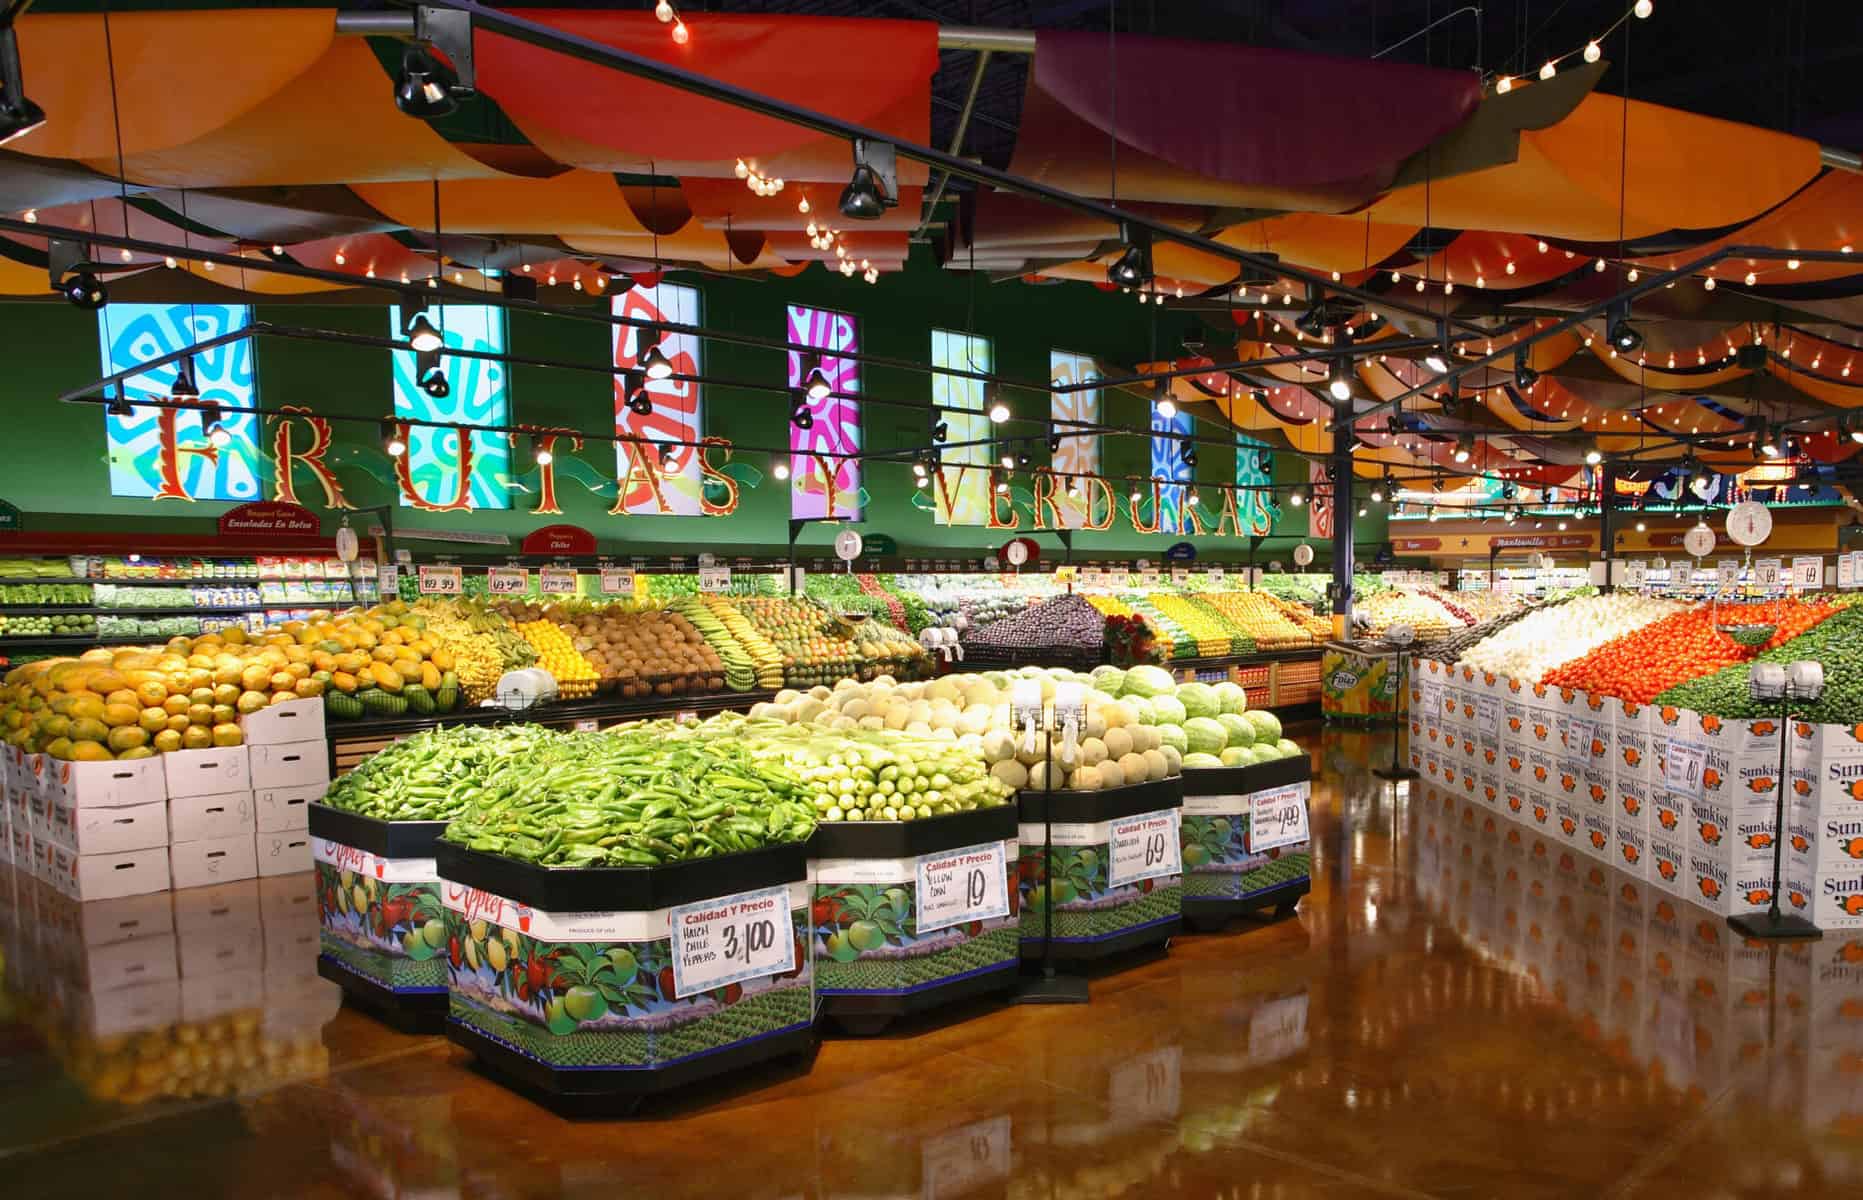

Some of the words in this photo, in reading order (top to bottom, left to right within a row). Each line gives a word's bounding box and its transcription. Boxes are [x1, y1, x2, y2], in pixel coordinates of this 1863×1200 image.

[145, 394, 738, 516] FRUTAS
[935, 464, 1272, 536] VERDURAS
[1617, 731, 1646, 751] Sunkist
[1705, 750, 1729, 773] kist
[1739, 765, 1781, 779] Sunkis
[1618, 780, 1646, 800] Sunkist
[1652, 789, 1684, 814] Sunkist
[1691, 801, 1728, 829] Sunkist
[1617, 826, 1645, 848] Sunkist
[1737, 821, 1778, 836] Sunkis
[1146, 833, 1165, 866] 69
[1651, 839, 1683, 866] Sunkist
[926, 859, 957, 872] Calidad
[959, 857, 965, 865] Y
[967, 853, 993, 865] Precio
[1691, 854, 1728, 885] Sunkist
[967, 868, 985, 909] 19
[685, 908, 728, 925] Calidad
[730, 905, 738, 915] Y
[740, 899, 774, 914] Precio
